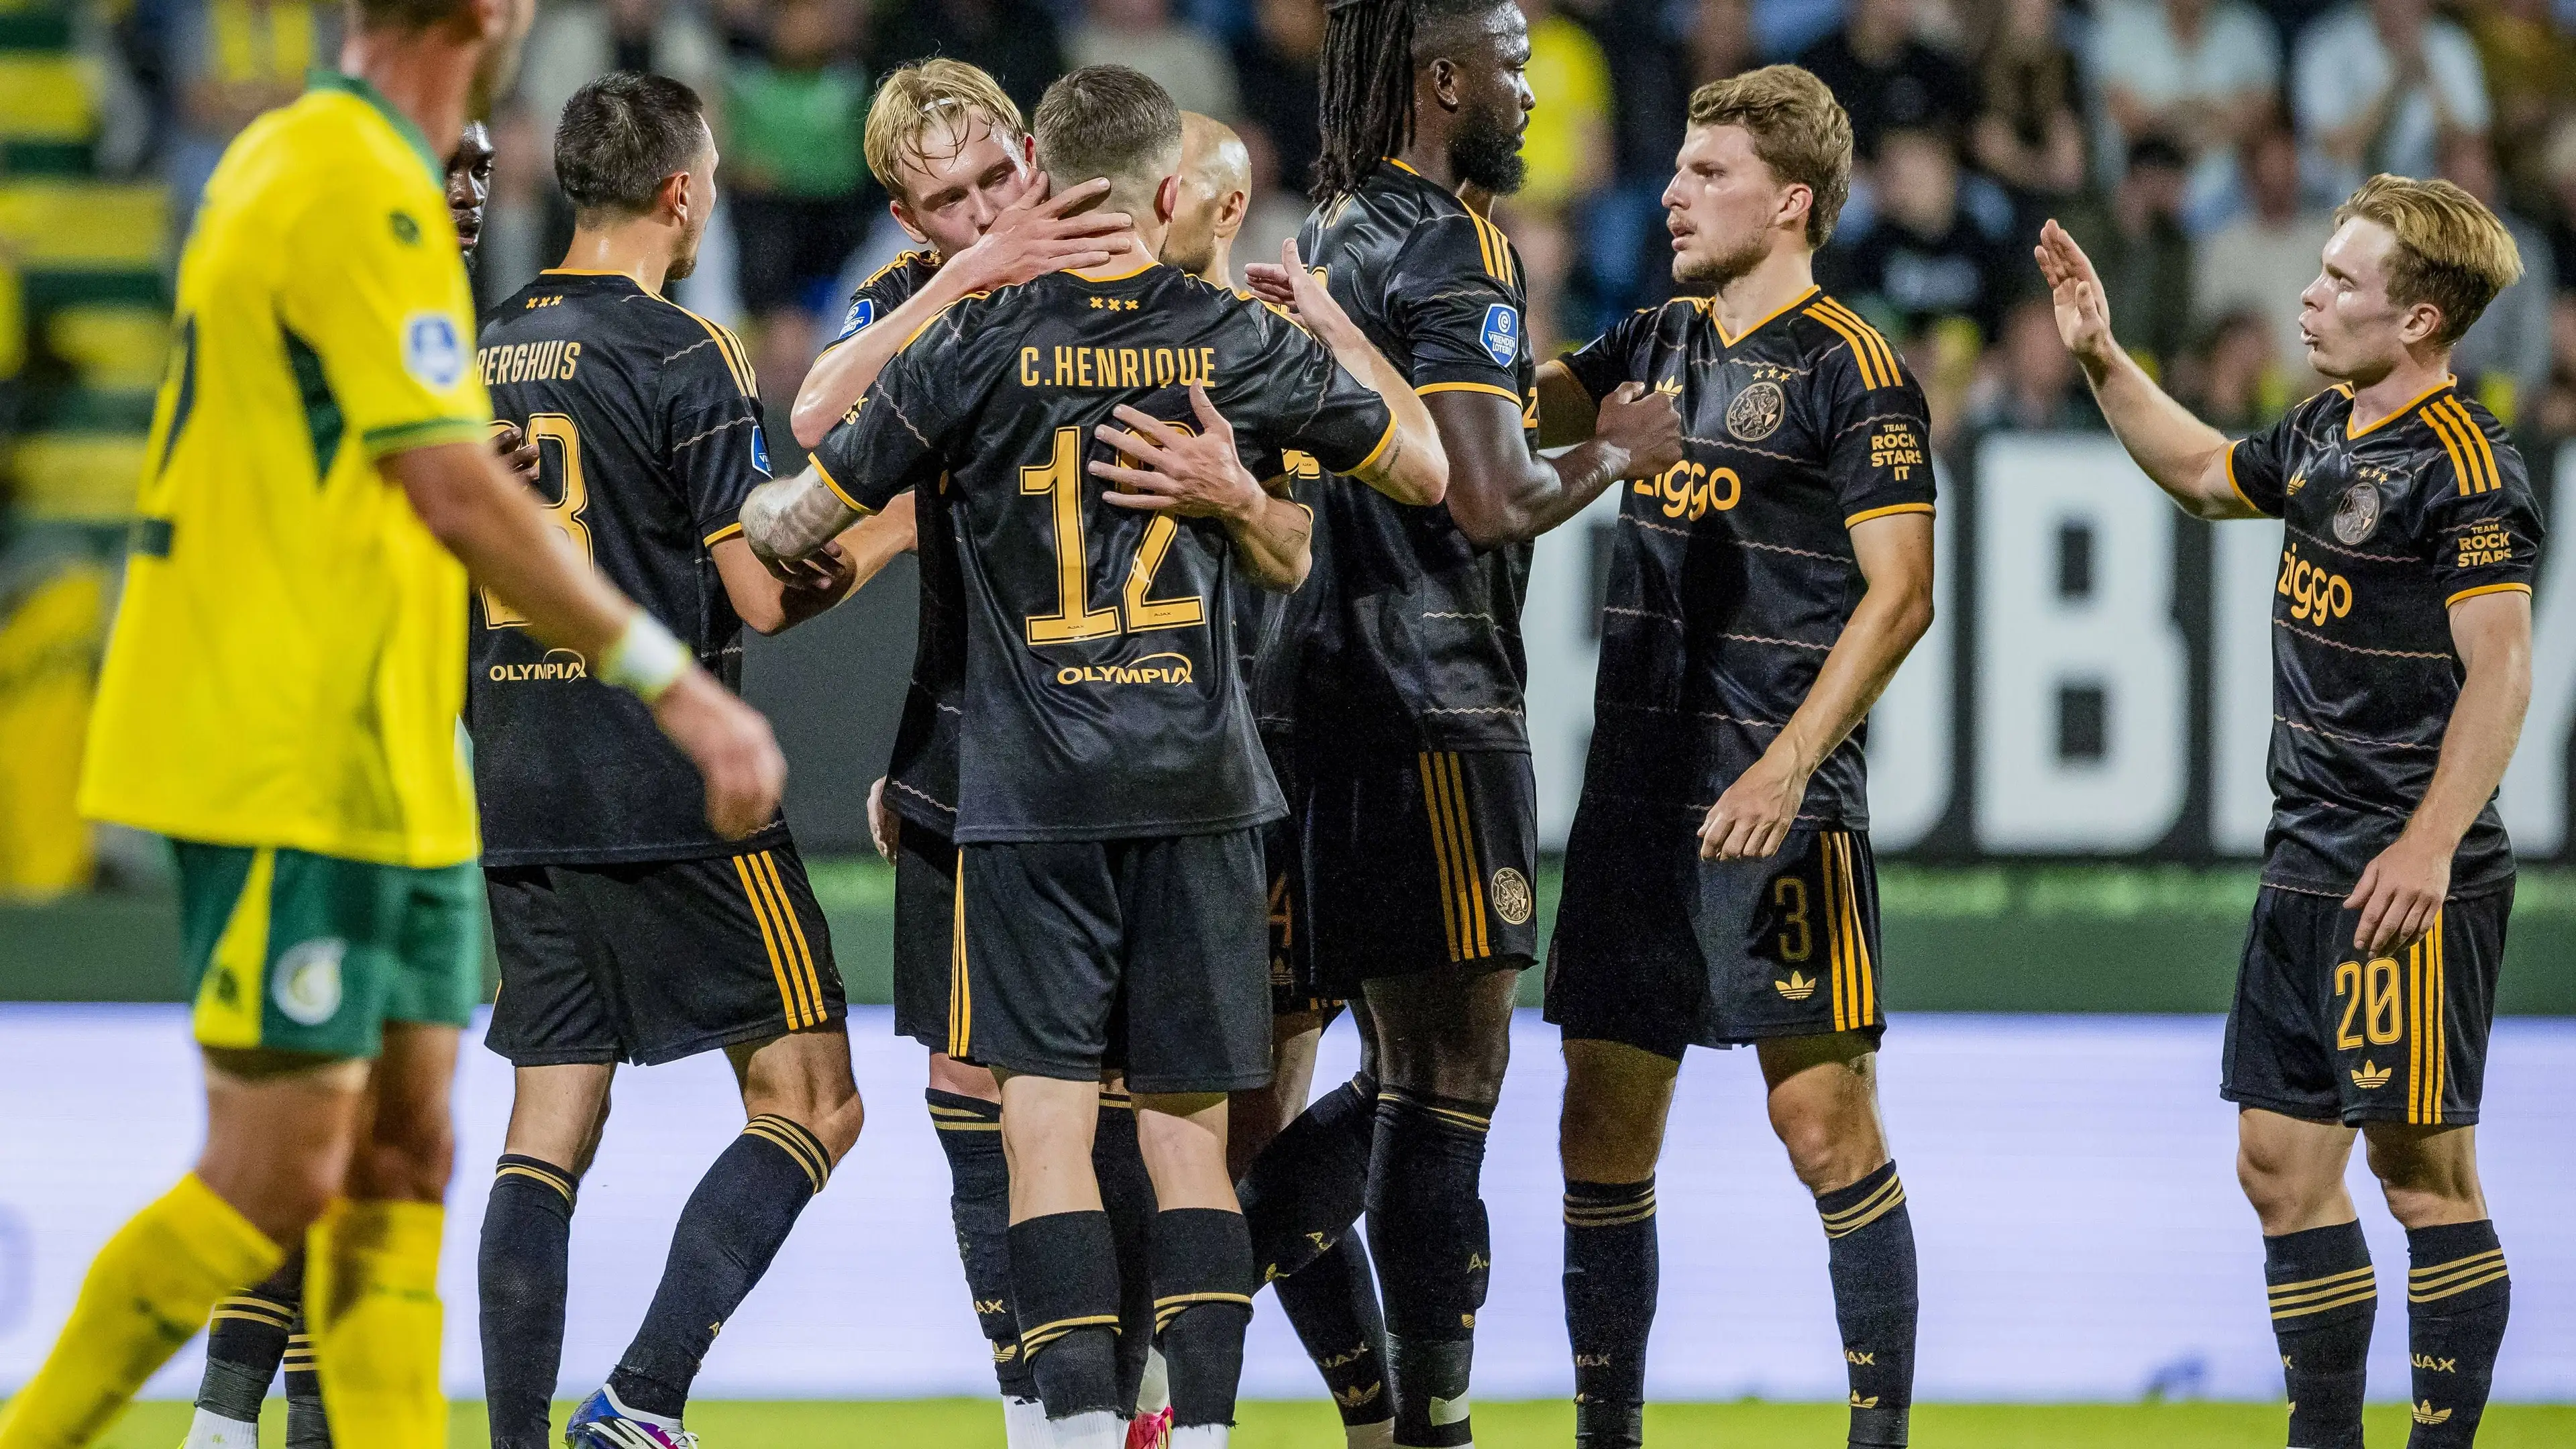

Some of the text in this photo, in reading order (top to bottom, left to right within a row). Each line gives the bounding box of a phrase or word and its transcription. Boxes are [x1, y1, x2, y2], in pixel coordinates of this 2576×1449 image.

[476, 339, 582, 386] BERGHUIS
[1020, 345, 1216, 389] C.HENRIQUE
[1883, 423, 1907, 433] TEAM
[1872, 433, 1918, 450] ROCK
[1871, 449, 1923, 468] STARS
[1894, 466, 1911, 481] IT
[1020, 421, 1206, 646] 12
[2471, 524, 2500, 534] TEAM
[2458, 531, 2510, 551] ROCK
[2457, 548, 2512, 568] STARS
[2277, 542, 2353, 627] ziggo
[489, 661, 588, 683] OLYMPIA
[1057, 665, 1193, 687] OLYMPIA
[1775, 876, 1812, 961] 3
[2334, 957, 2402, 1051] 20
